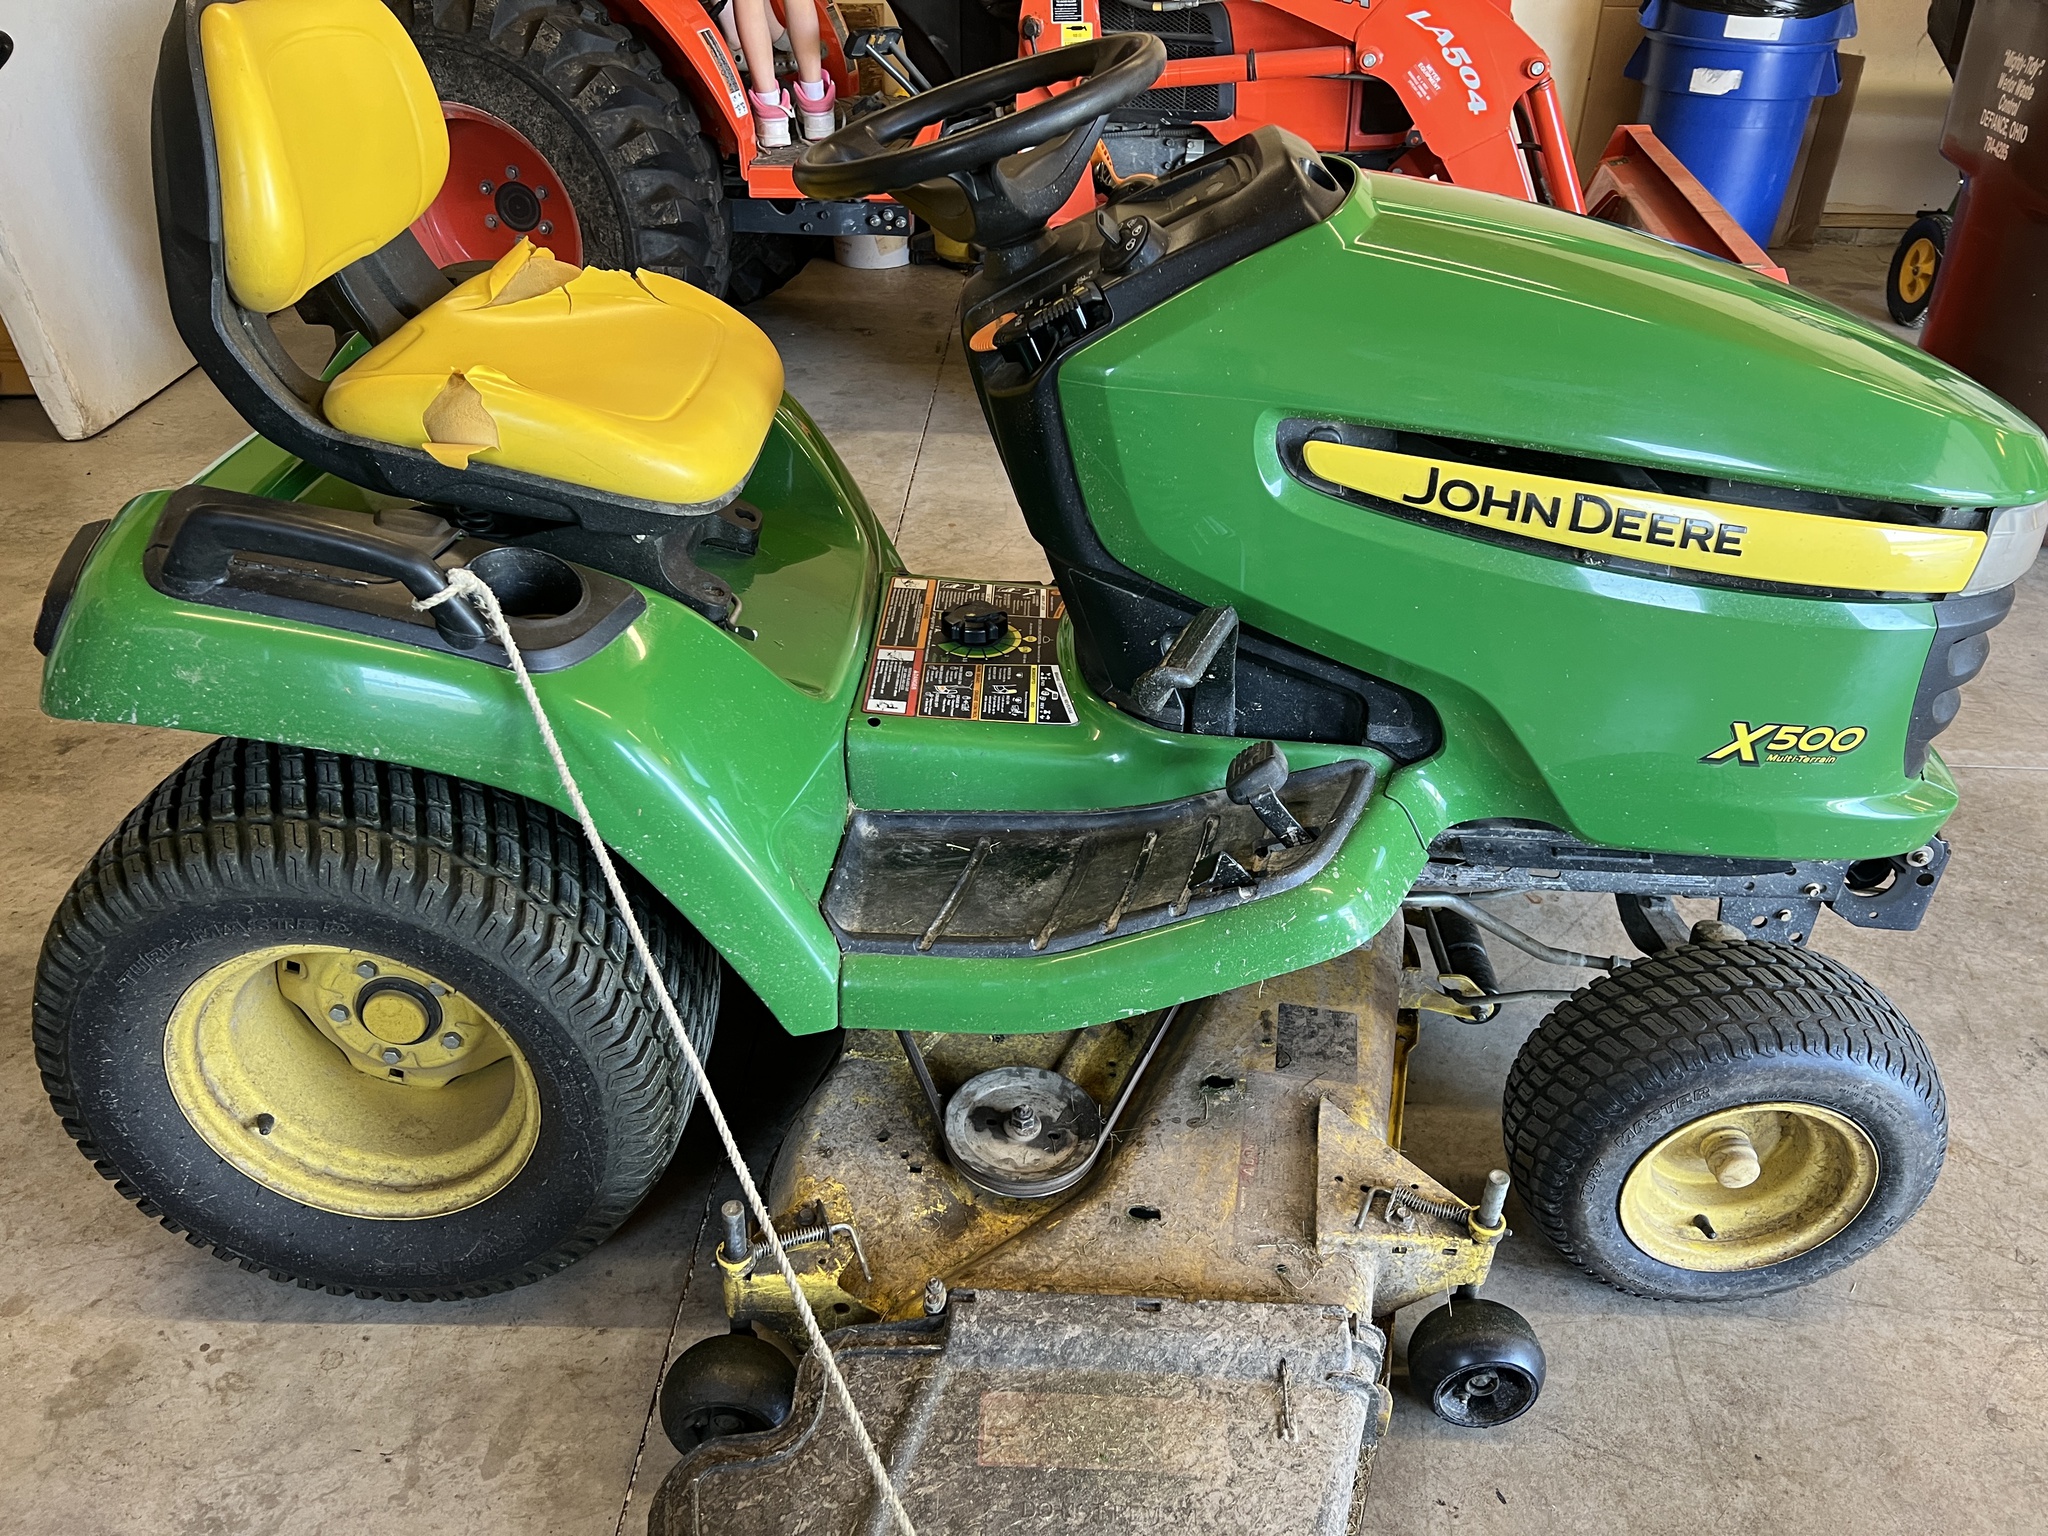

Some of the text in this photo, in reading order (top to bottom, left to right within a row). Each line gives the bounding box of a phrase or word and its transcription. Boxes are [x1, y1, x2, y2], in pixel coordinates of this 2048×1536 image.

[1405, 10, 1487, 115] LA504
[2008, 121, 2029, 144] OHIO
[1402, 467, 1748, 557] JOHN DEERE
[1699, 721, 1868, 767] X500
[1765, 753, 1837, 764] Multi-Terrain
[1580, 1157, 1606, 1202] TURF
[1613, 1086, 1712, 1149] MASTER
